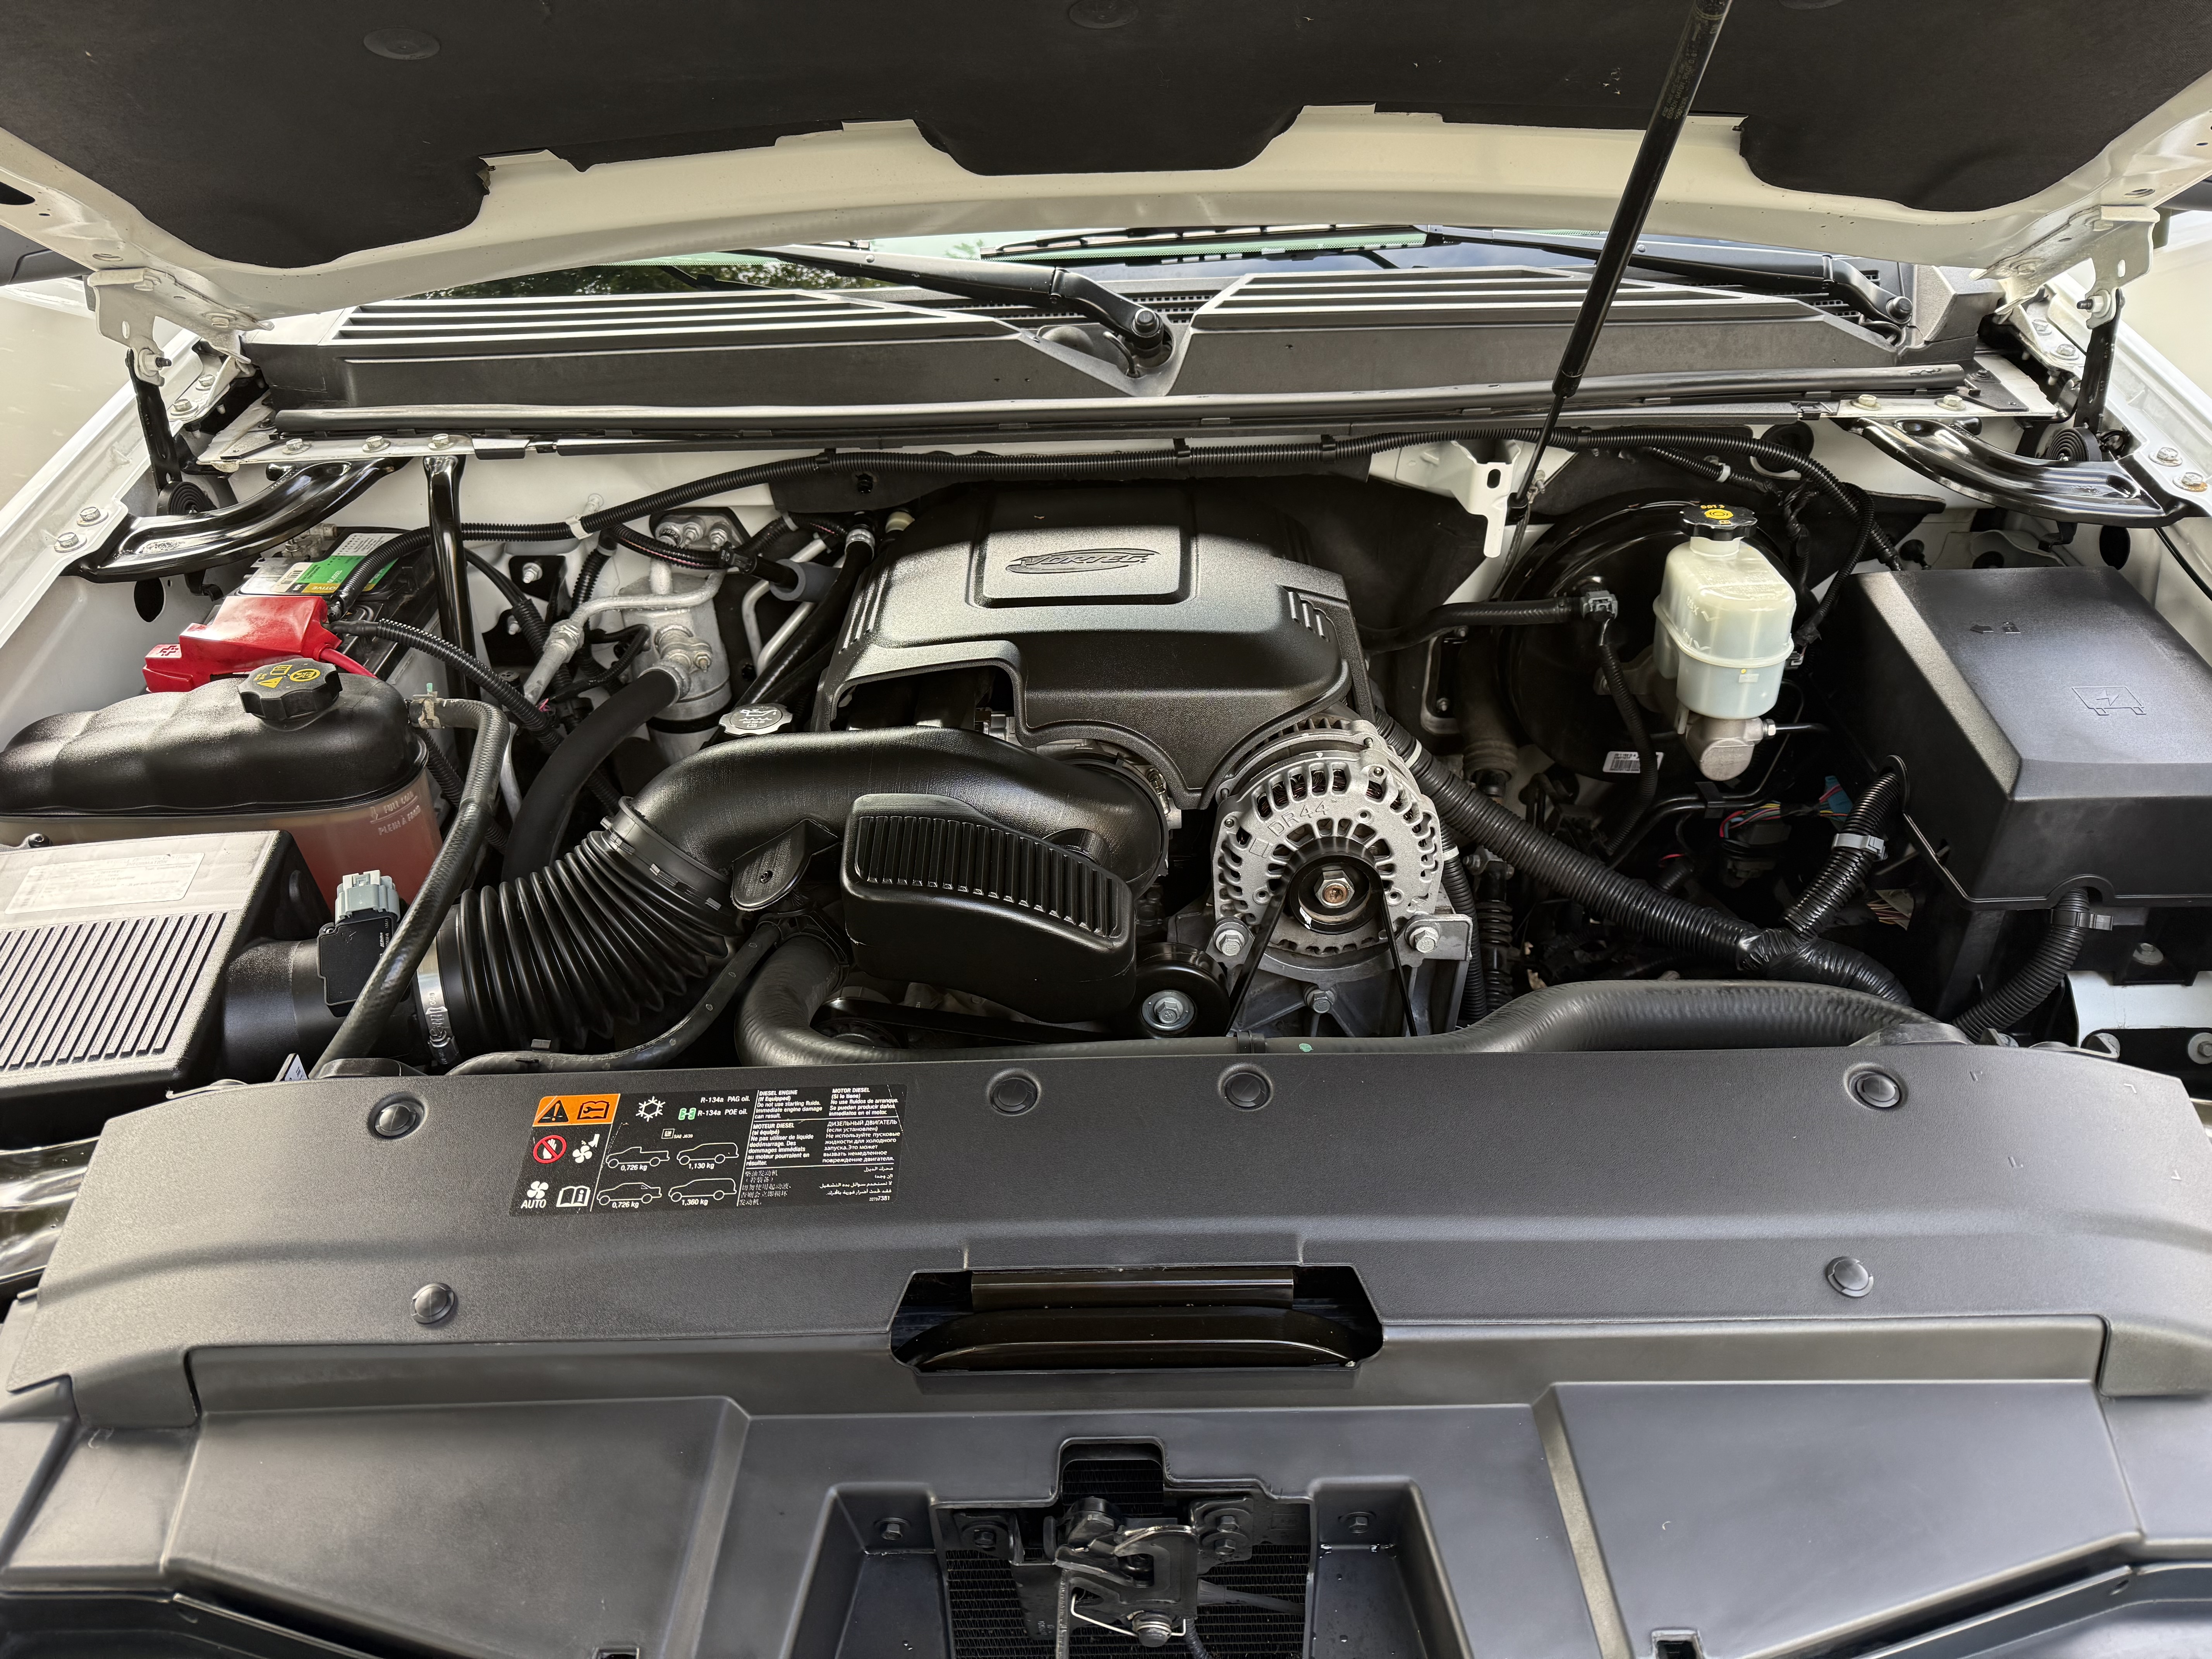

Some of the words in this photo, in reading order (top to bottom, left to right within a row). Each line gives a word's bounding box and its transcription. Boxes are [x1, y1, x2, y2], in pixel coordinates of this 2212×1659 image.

[1021, 553, 1149, 565] VORTEC
[383, 800, 400, 813] FULL
[378, 820, 401, 836] PLEIN
[521, 1199, 546, 1209] AUTO
